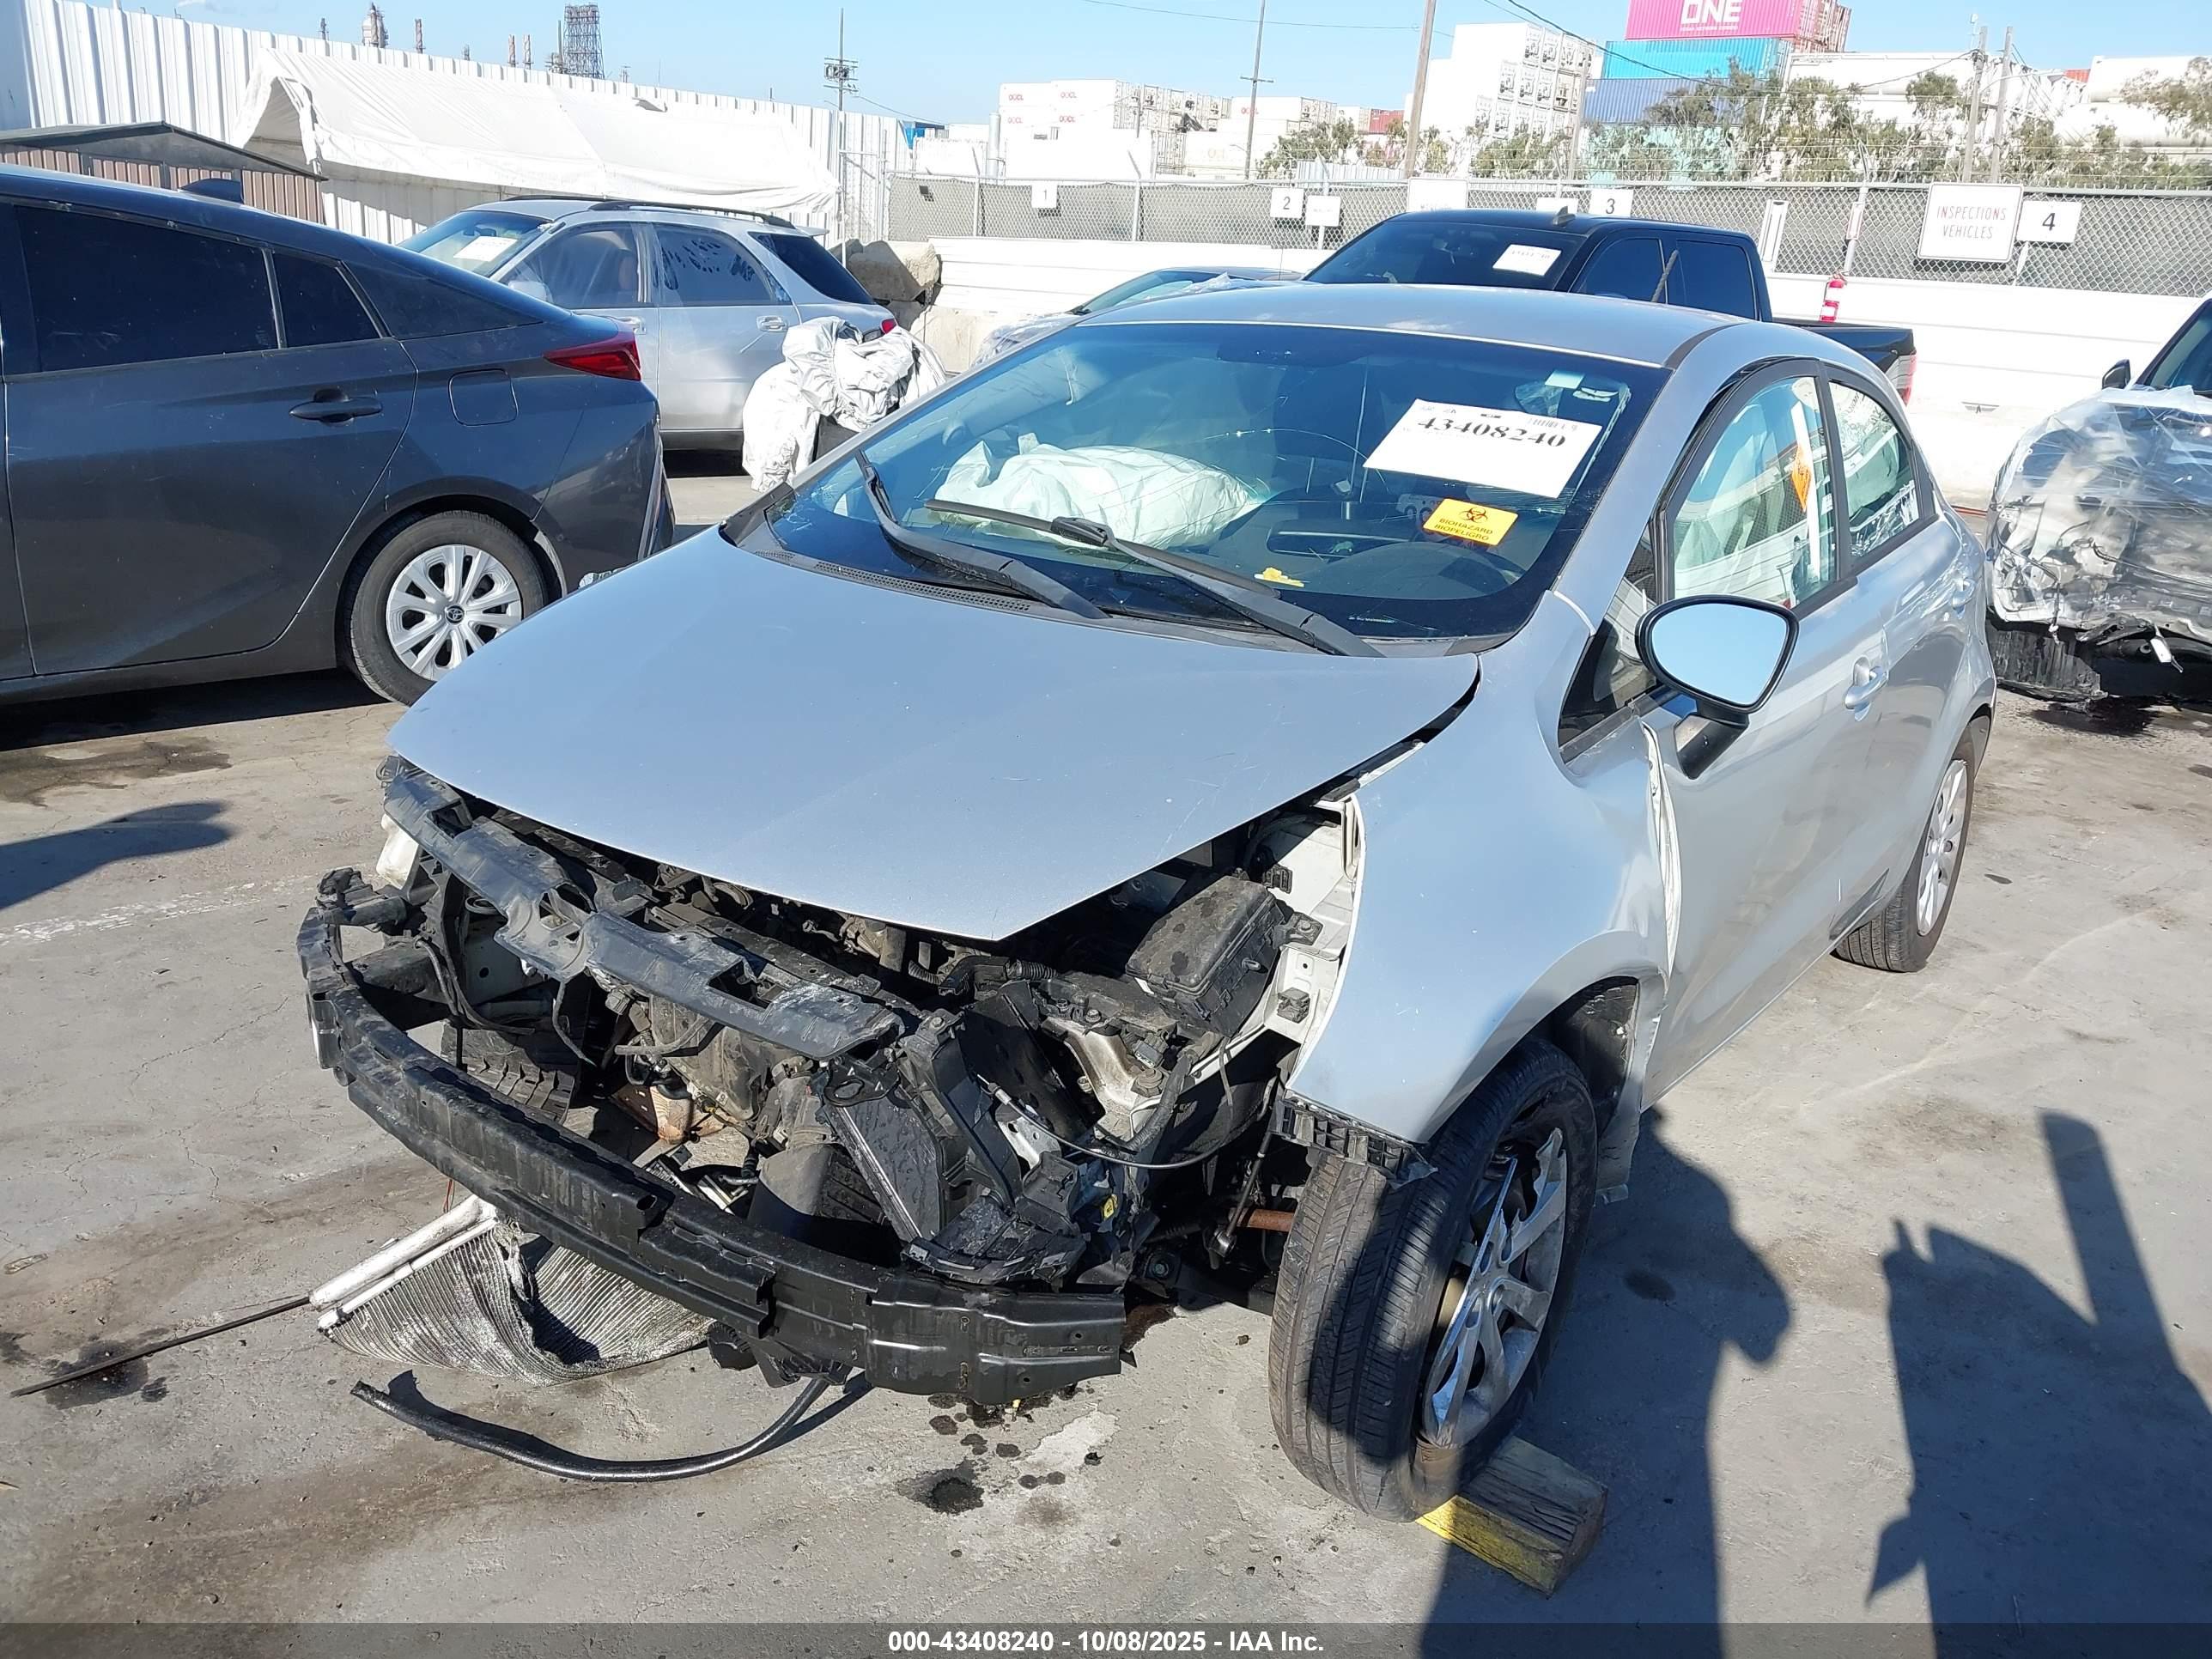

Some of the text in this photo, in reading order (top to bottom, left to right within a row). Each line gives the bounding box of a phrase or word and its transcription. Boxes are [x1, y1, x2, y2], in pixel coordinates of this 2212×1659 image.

[1680, 0, 1743, 24] ONE
[1283, 196, 1291, 210] 2
[1605, 198, 1616, 215] 3
[1936, 205, 2007, 221] INSPECTIONS
[2042, 212, 2056, 231] 4
[1942, 225, 1993, 240] VEHICLES
[1417, 417, 1567, 448] 43408240
[1434, 524, 1490, 541] BIOPELIGRO
[1438, 518, 1493, 535] BIOHAZARD
